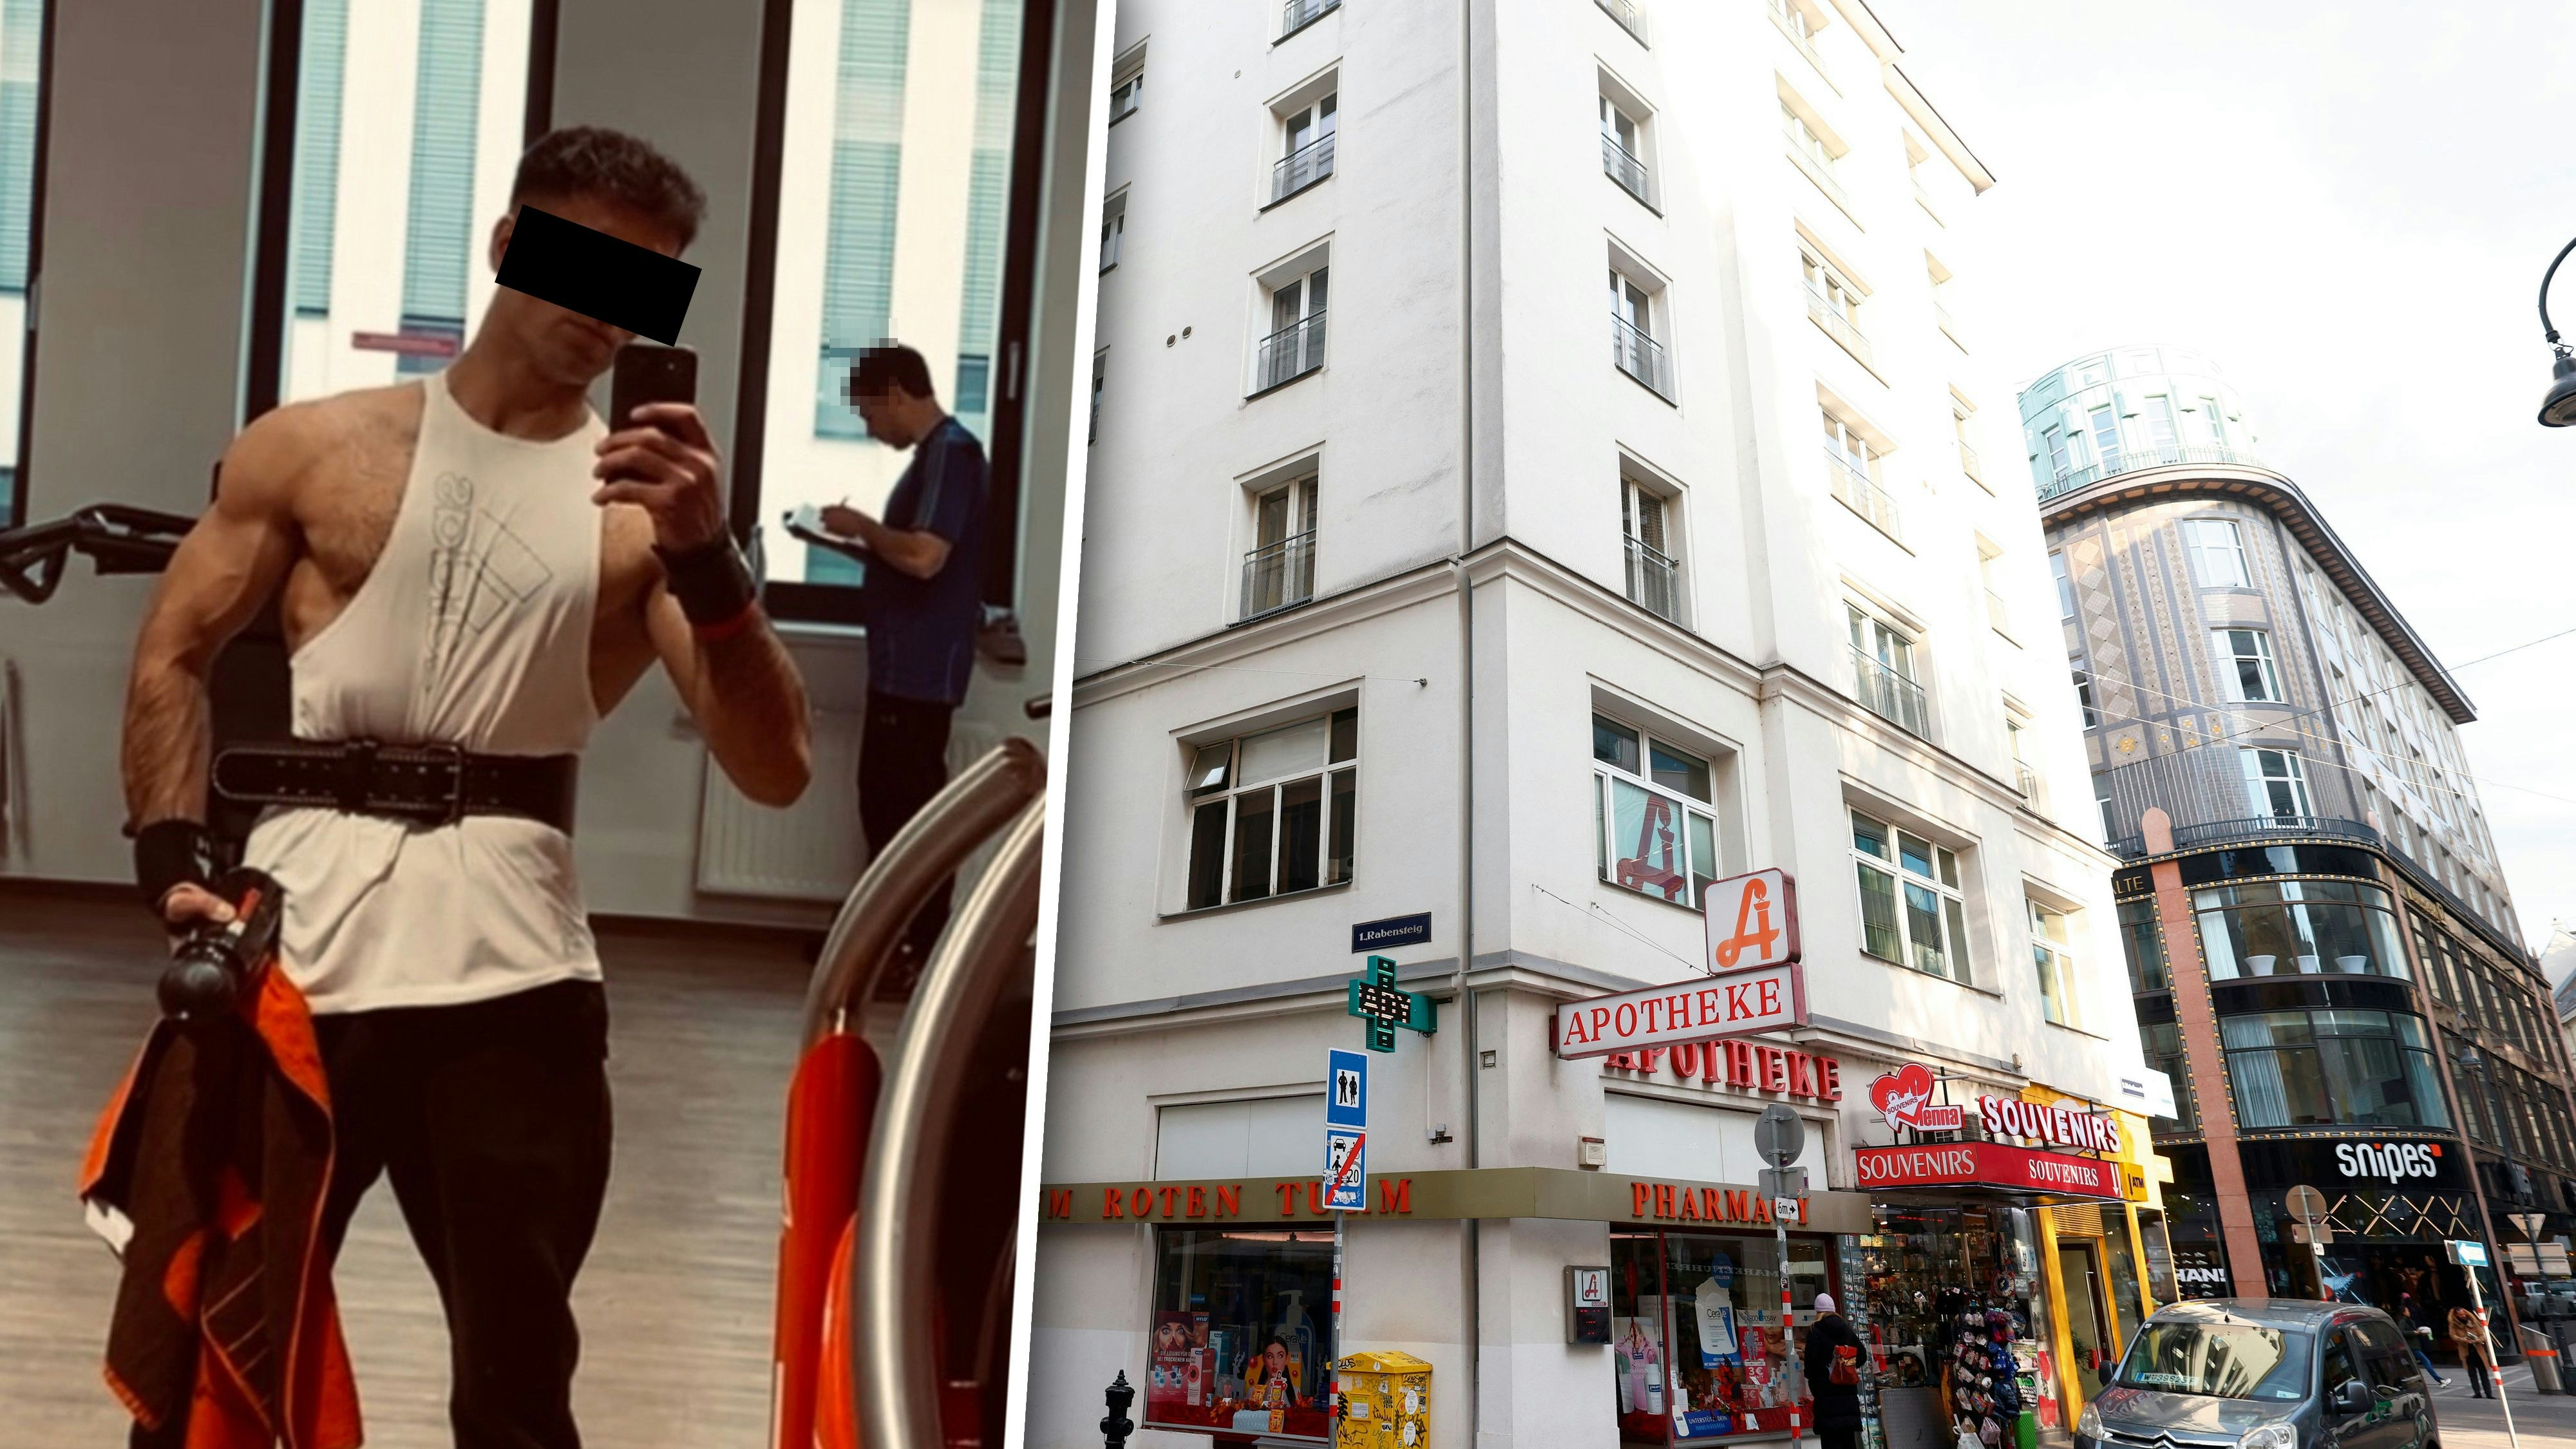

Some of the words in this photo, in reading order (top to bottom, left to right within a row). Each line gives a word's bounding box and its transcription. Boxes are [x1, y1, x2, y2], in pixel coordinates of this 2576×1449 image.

[1564, 978, 1782, 1046] APOTHEKE
[1887, 1097, 1918, 1115] SOUVENIRS
[1979, 1095, 2121, 1153] SOUVENIRS
[1859, 1150, 1975, 1180] SOUVENIRS
[2029, 1159, 2099, 1188] SOUVENIRS
[2336, 1143, 2437, 1184] snipes
[2132, 1176, 2145, 1188] ATM
[1041, 1189, 1072, 1218] M
[1102, 1184, 1242, 1218] ROTEN
[1276, 1179, 1412, 1216] TUM
[1631, 1182, 1810, 1225] PHARMAY
[1778, 1202, 1788, 1215] 6m
[2015, 1278, 2027, 1287] CASH
